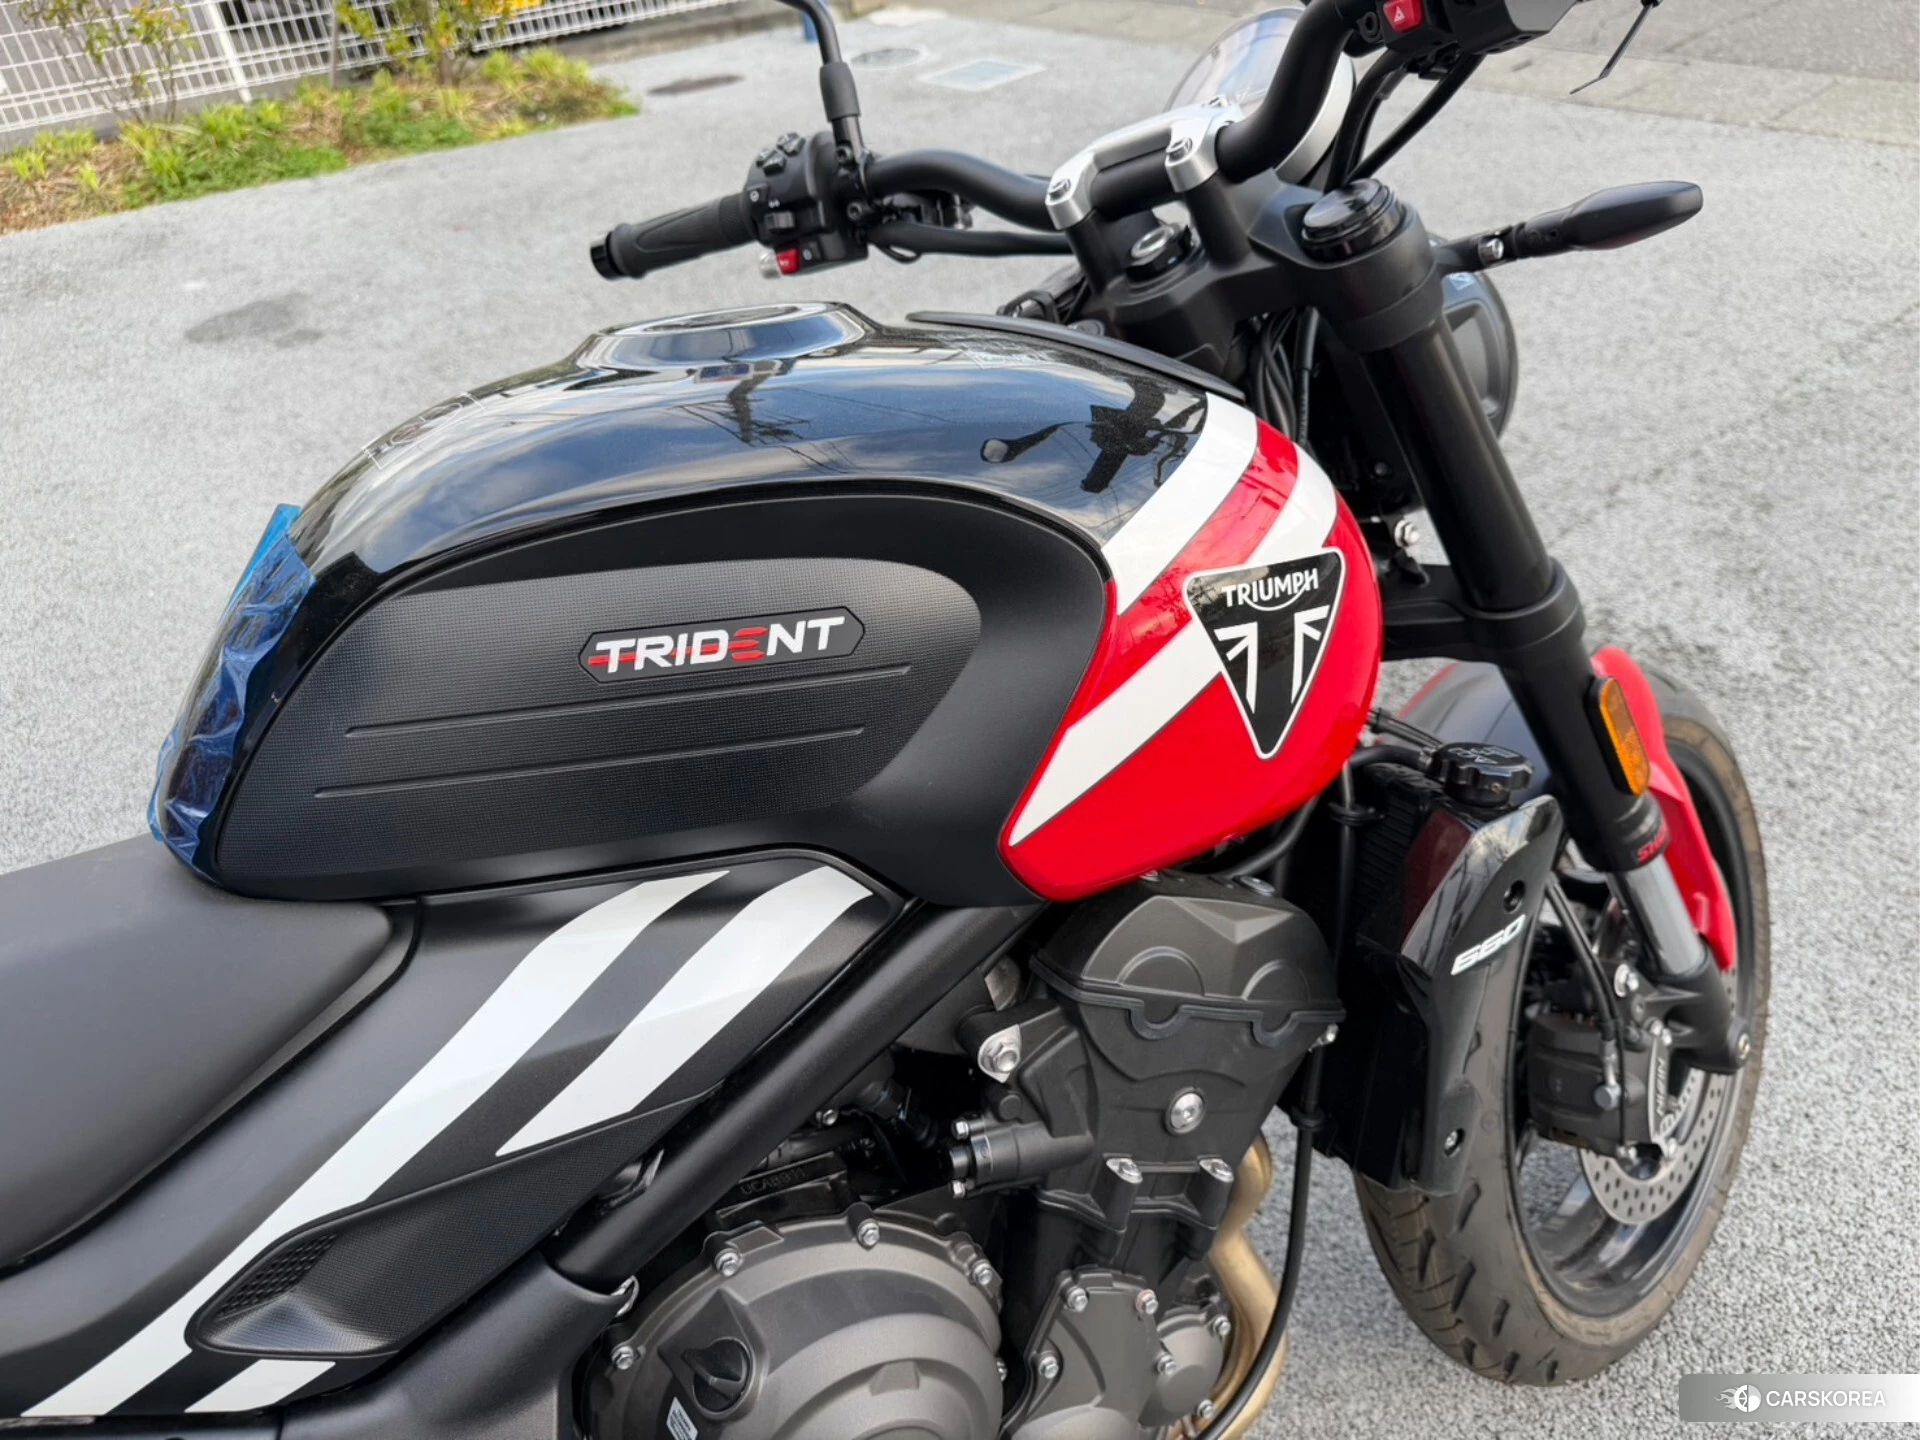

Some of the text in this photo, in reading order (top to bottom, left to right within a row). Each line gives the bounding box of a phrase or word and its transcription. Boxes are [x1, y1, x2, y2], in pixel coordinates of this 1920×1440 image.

[1221, 568, 1319, 610] TRIUMPH
[589, 616, 845, 674] TRIDENT
[1450, 914, 1526, 976] 660
